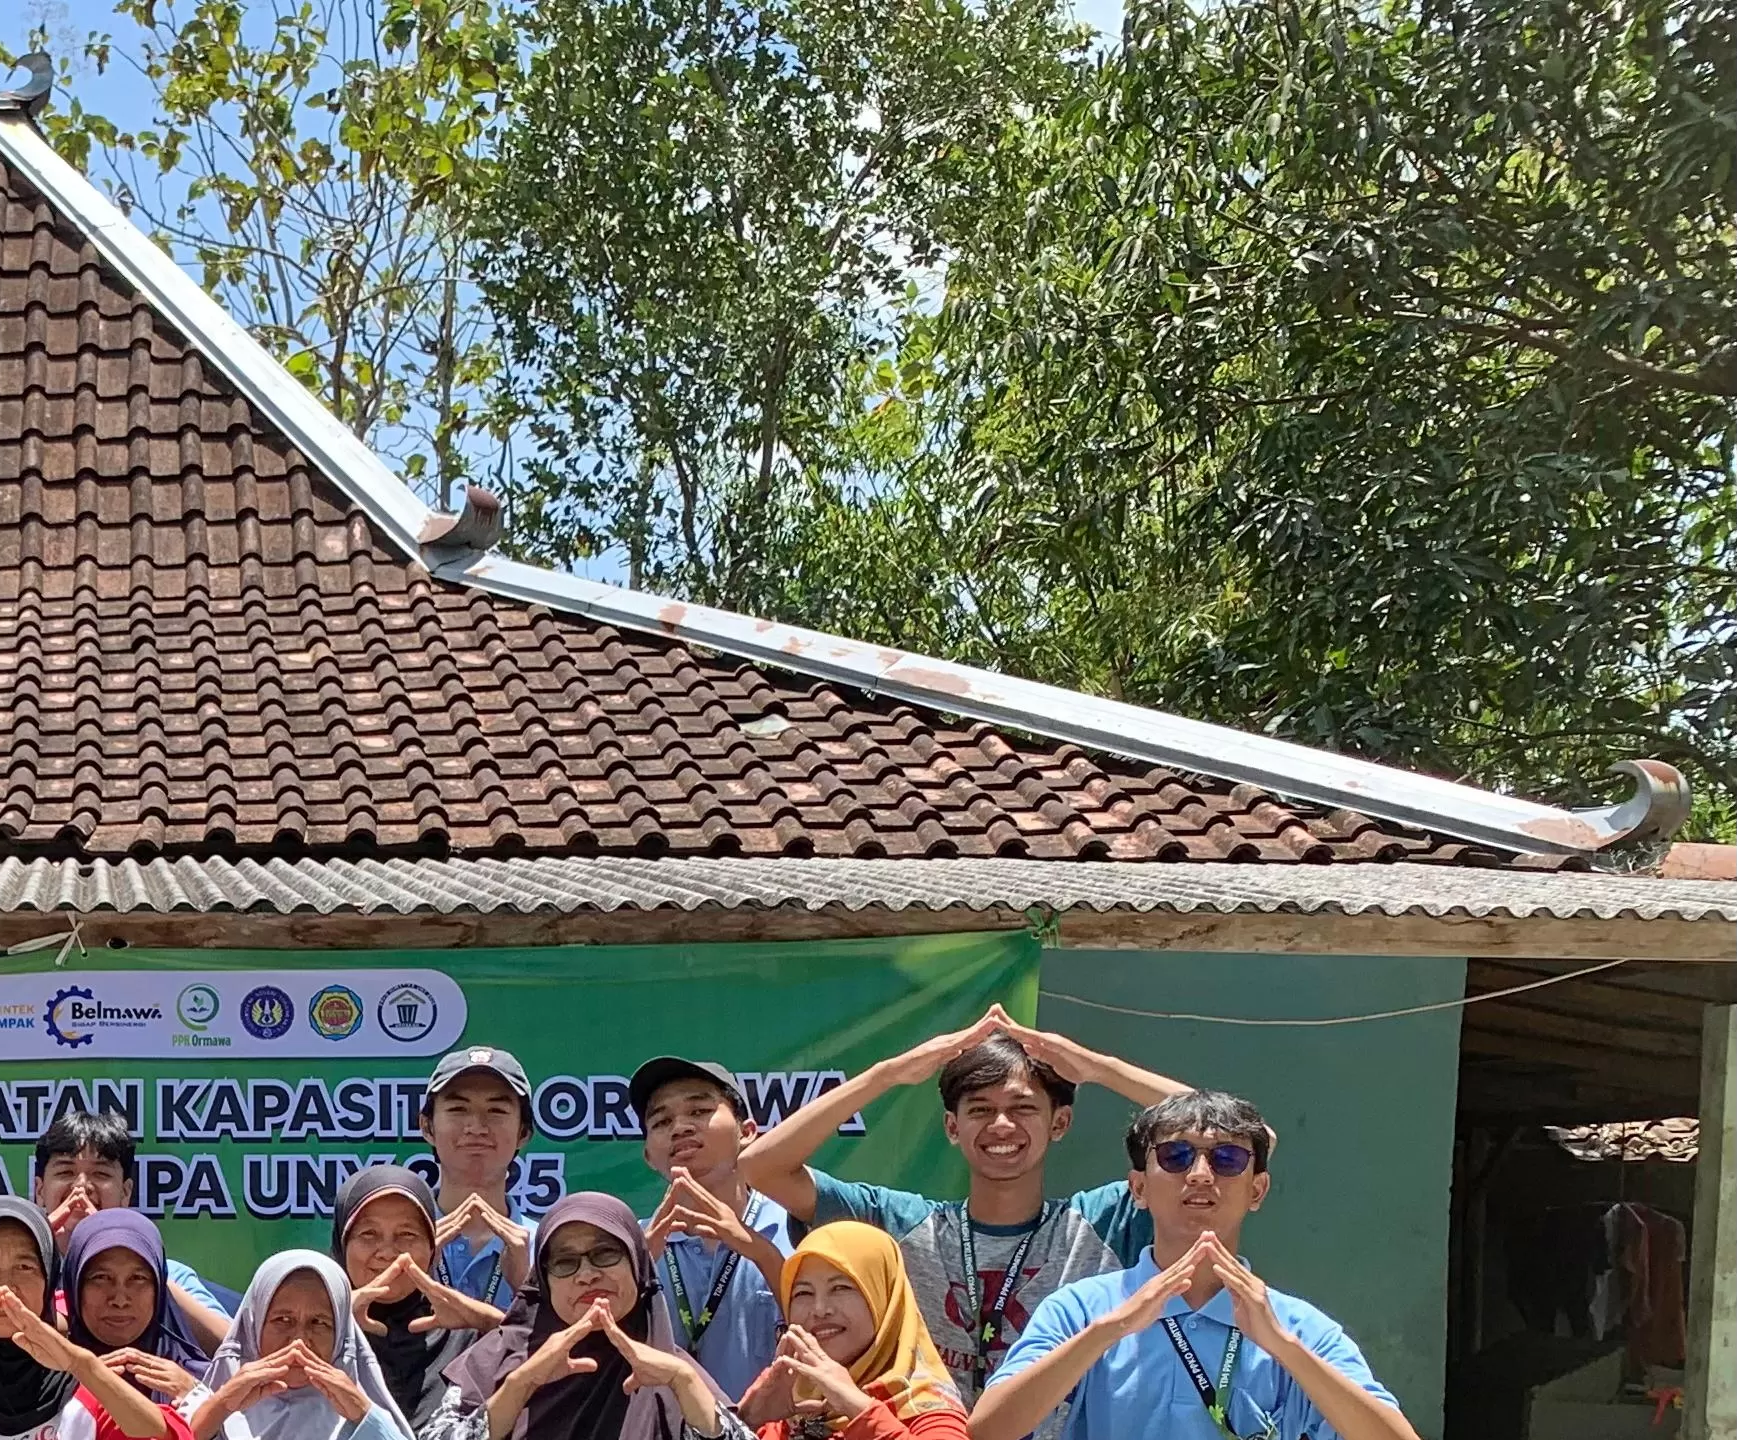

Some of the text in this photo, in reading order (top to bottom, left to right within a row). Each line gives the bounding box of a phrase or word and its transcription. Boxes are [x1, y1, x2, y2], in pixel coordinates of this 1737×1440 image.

[71, 1001, 162, 1020] Belmawa
[192, 1034, 231, 1047] Ormawa
[156, 1076, 432, 1142] KAPASIT
[536, 1068, 866, 1139] ORW
[719, 1263, 733, 1283] PPKO
[1183, 1351, 1200, 1374] PPKO
[1222, 1352, 1234, 1372] PPKO
[1195, 1372, 1209, 1390] TIM
[1218, 1373, 1229, 1389] TIM
